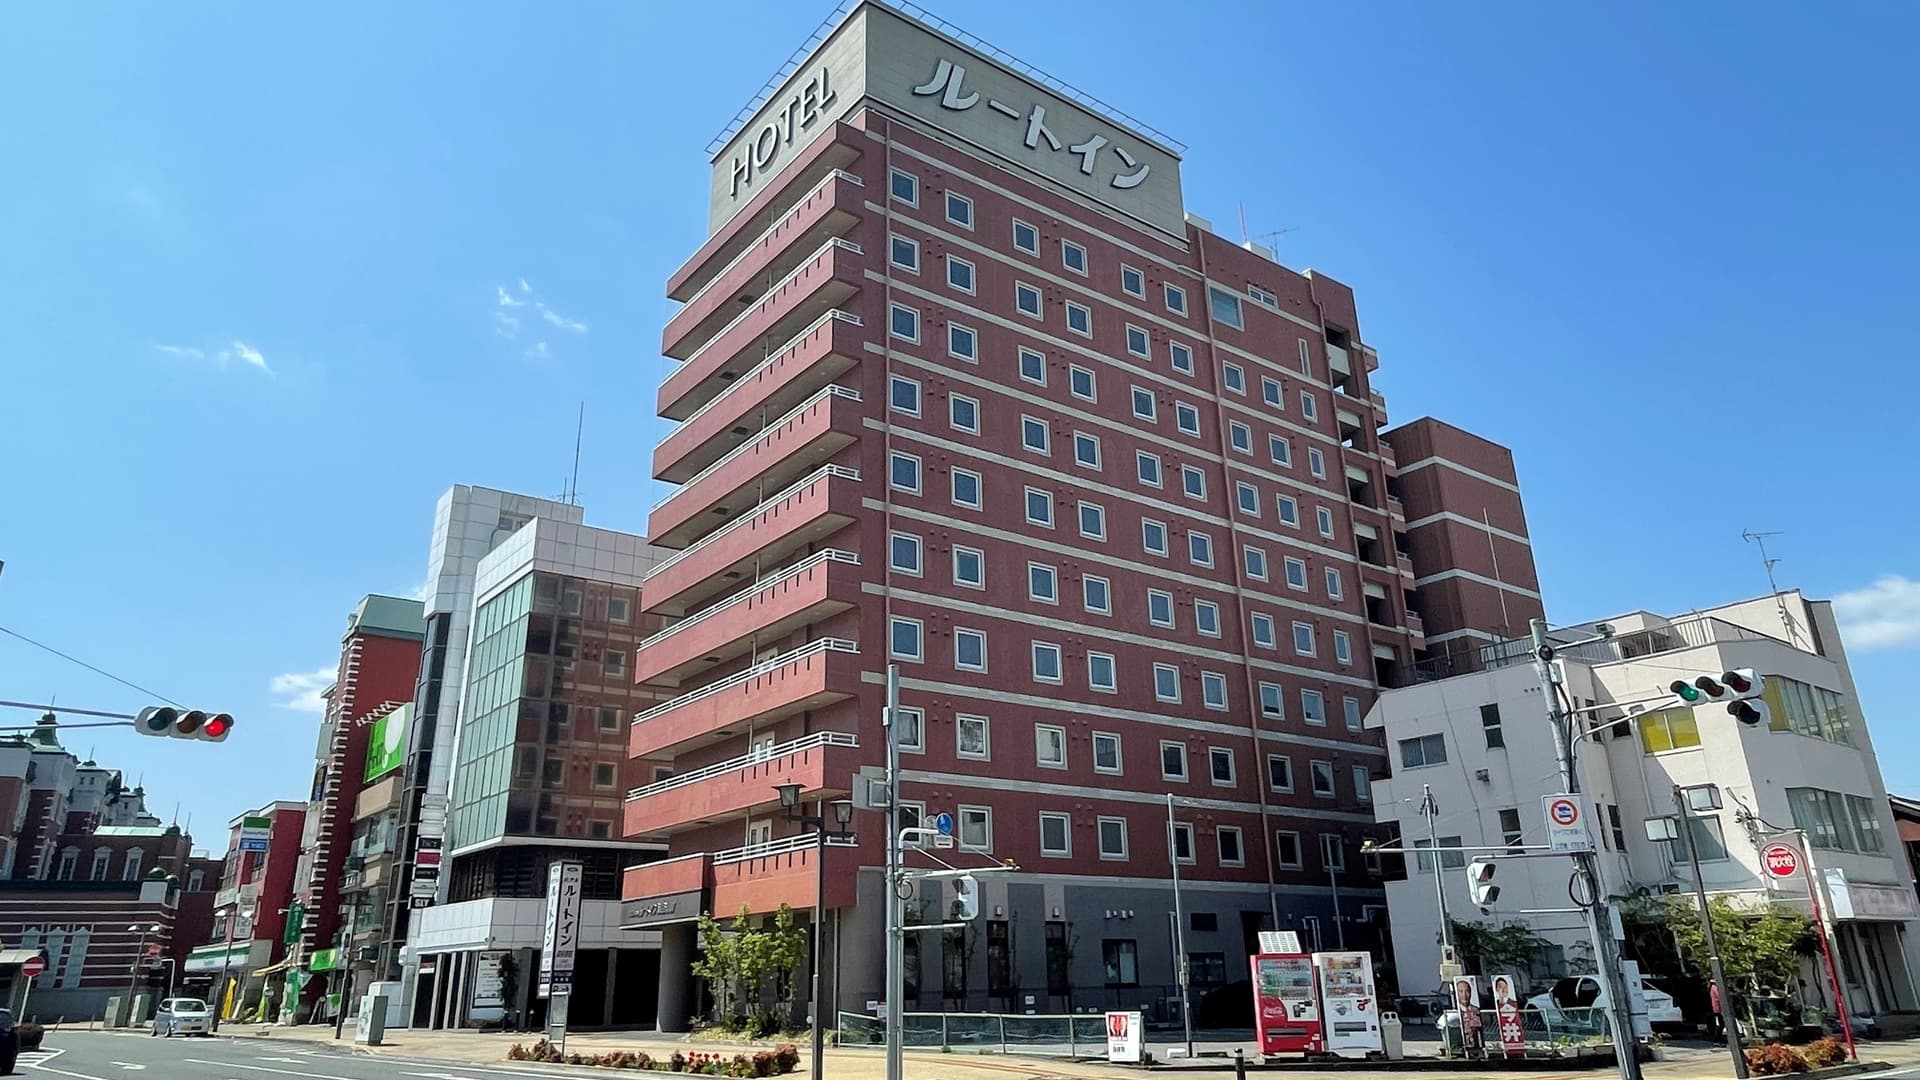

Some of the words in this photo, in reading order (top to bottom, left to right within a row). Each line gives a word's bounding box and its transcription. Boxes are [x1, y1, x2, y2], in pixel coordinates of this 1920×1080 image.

[729, 65, 839, 200] HOTEL
[912, 58, 1150, 189] ルートイン
[560, 885, 577, 947] ルートイン
